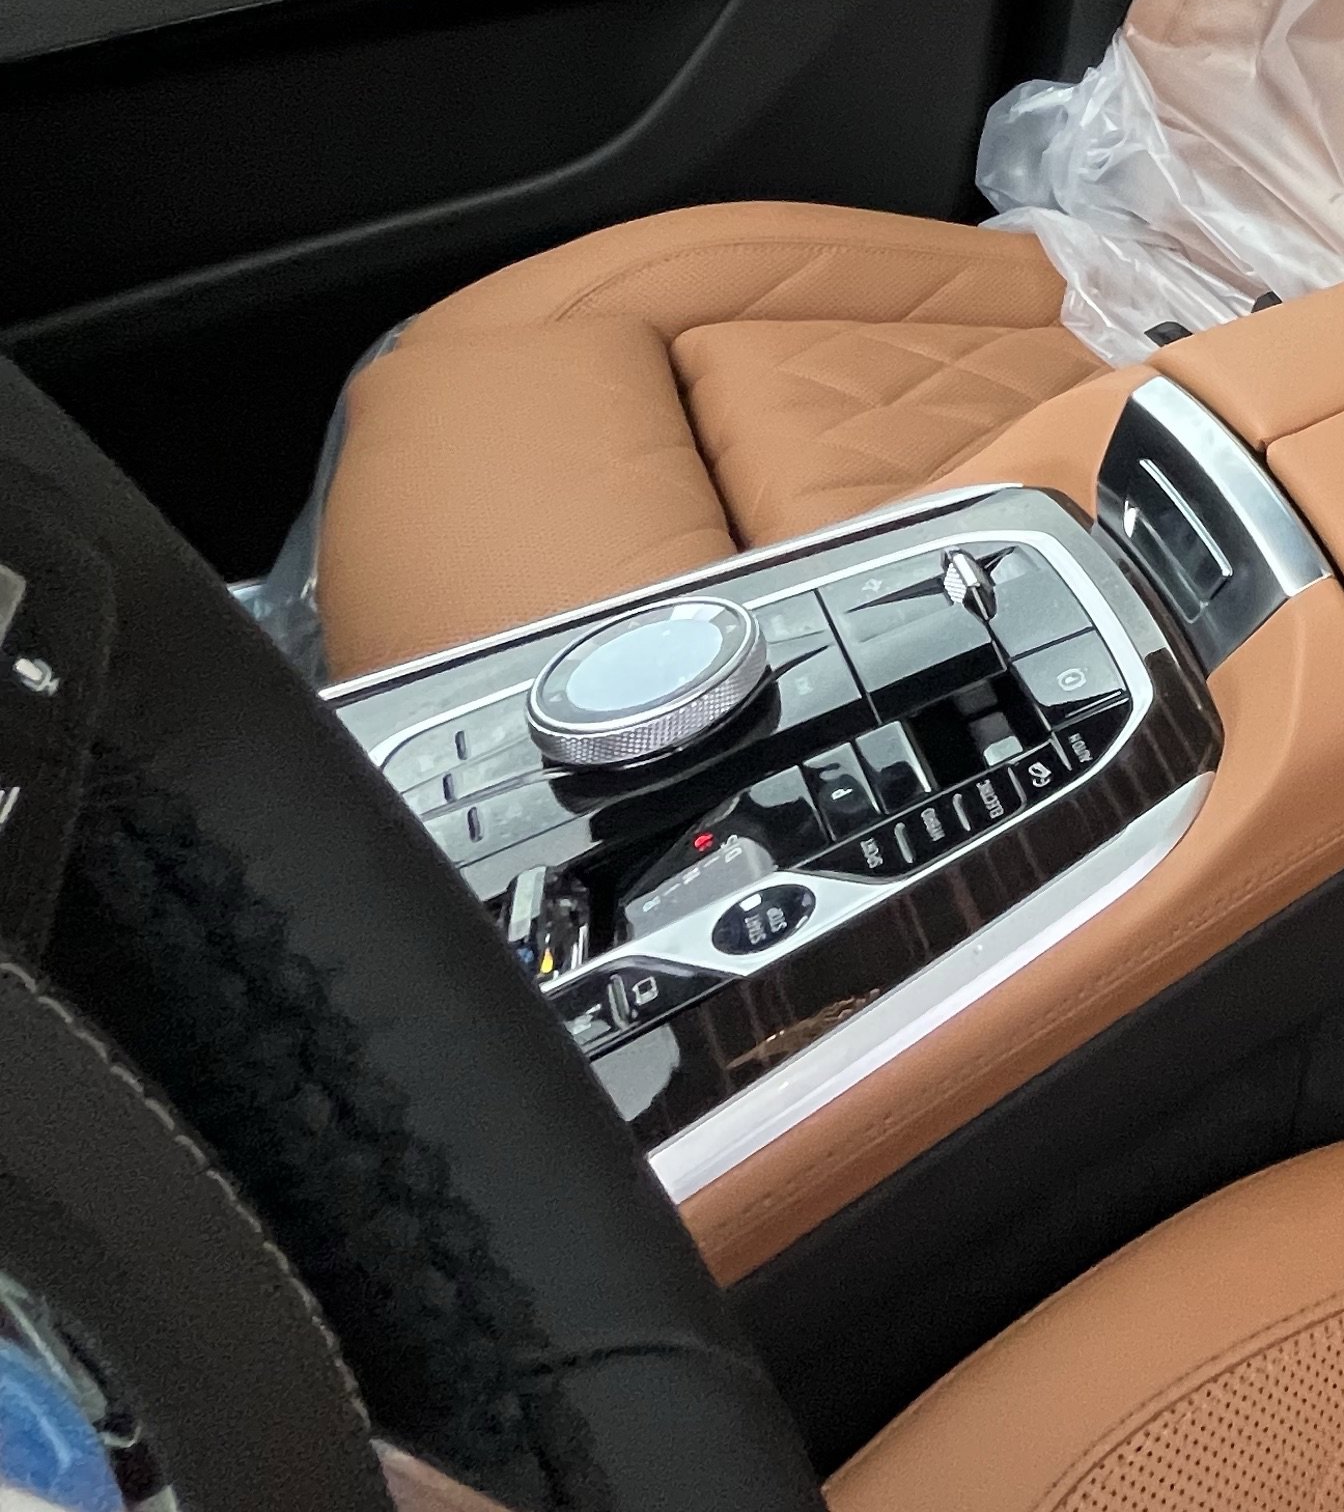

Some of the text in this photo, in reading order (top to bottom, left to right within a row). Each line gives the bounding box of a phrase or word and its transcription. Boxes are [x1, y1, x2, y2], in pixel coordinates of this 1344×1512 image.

[830, 787, 854, 801] P
[976, 778, 1005, 819] ELECTRIC
[744, 914, 768, 946] START
[766, 906, 788, 934] STOP
